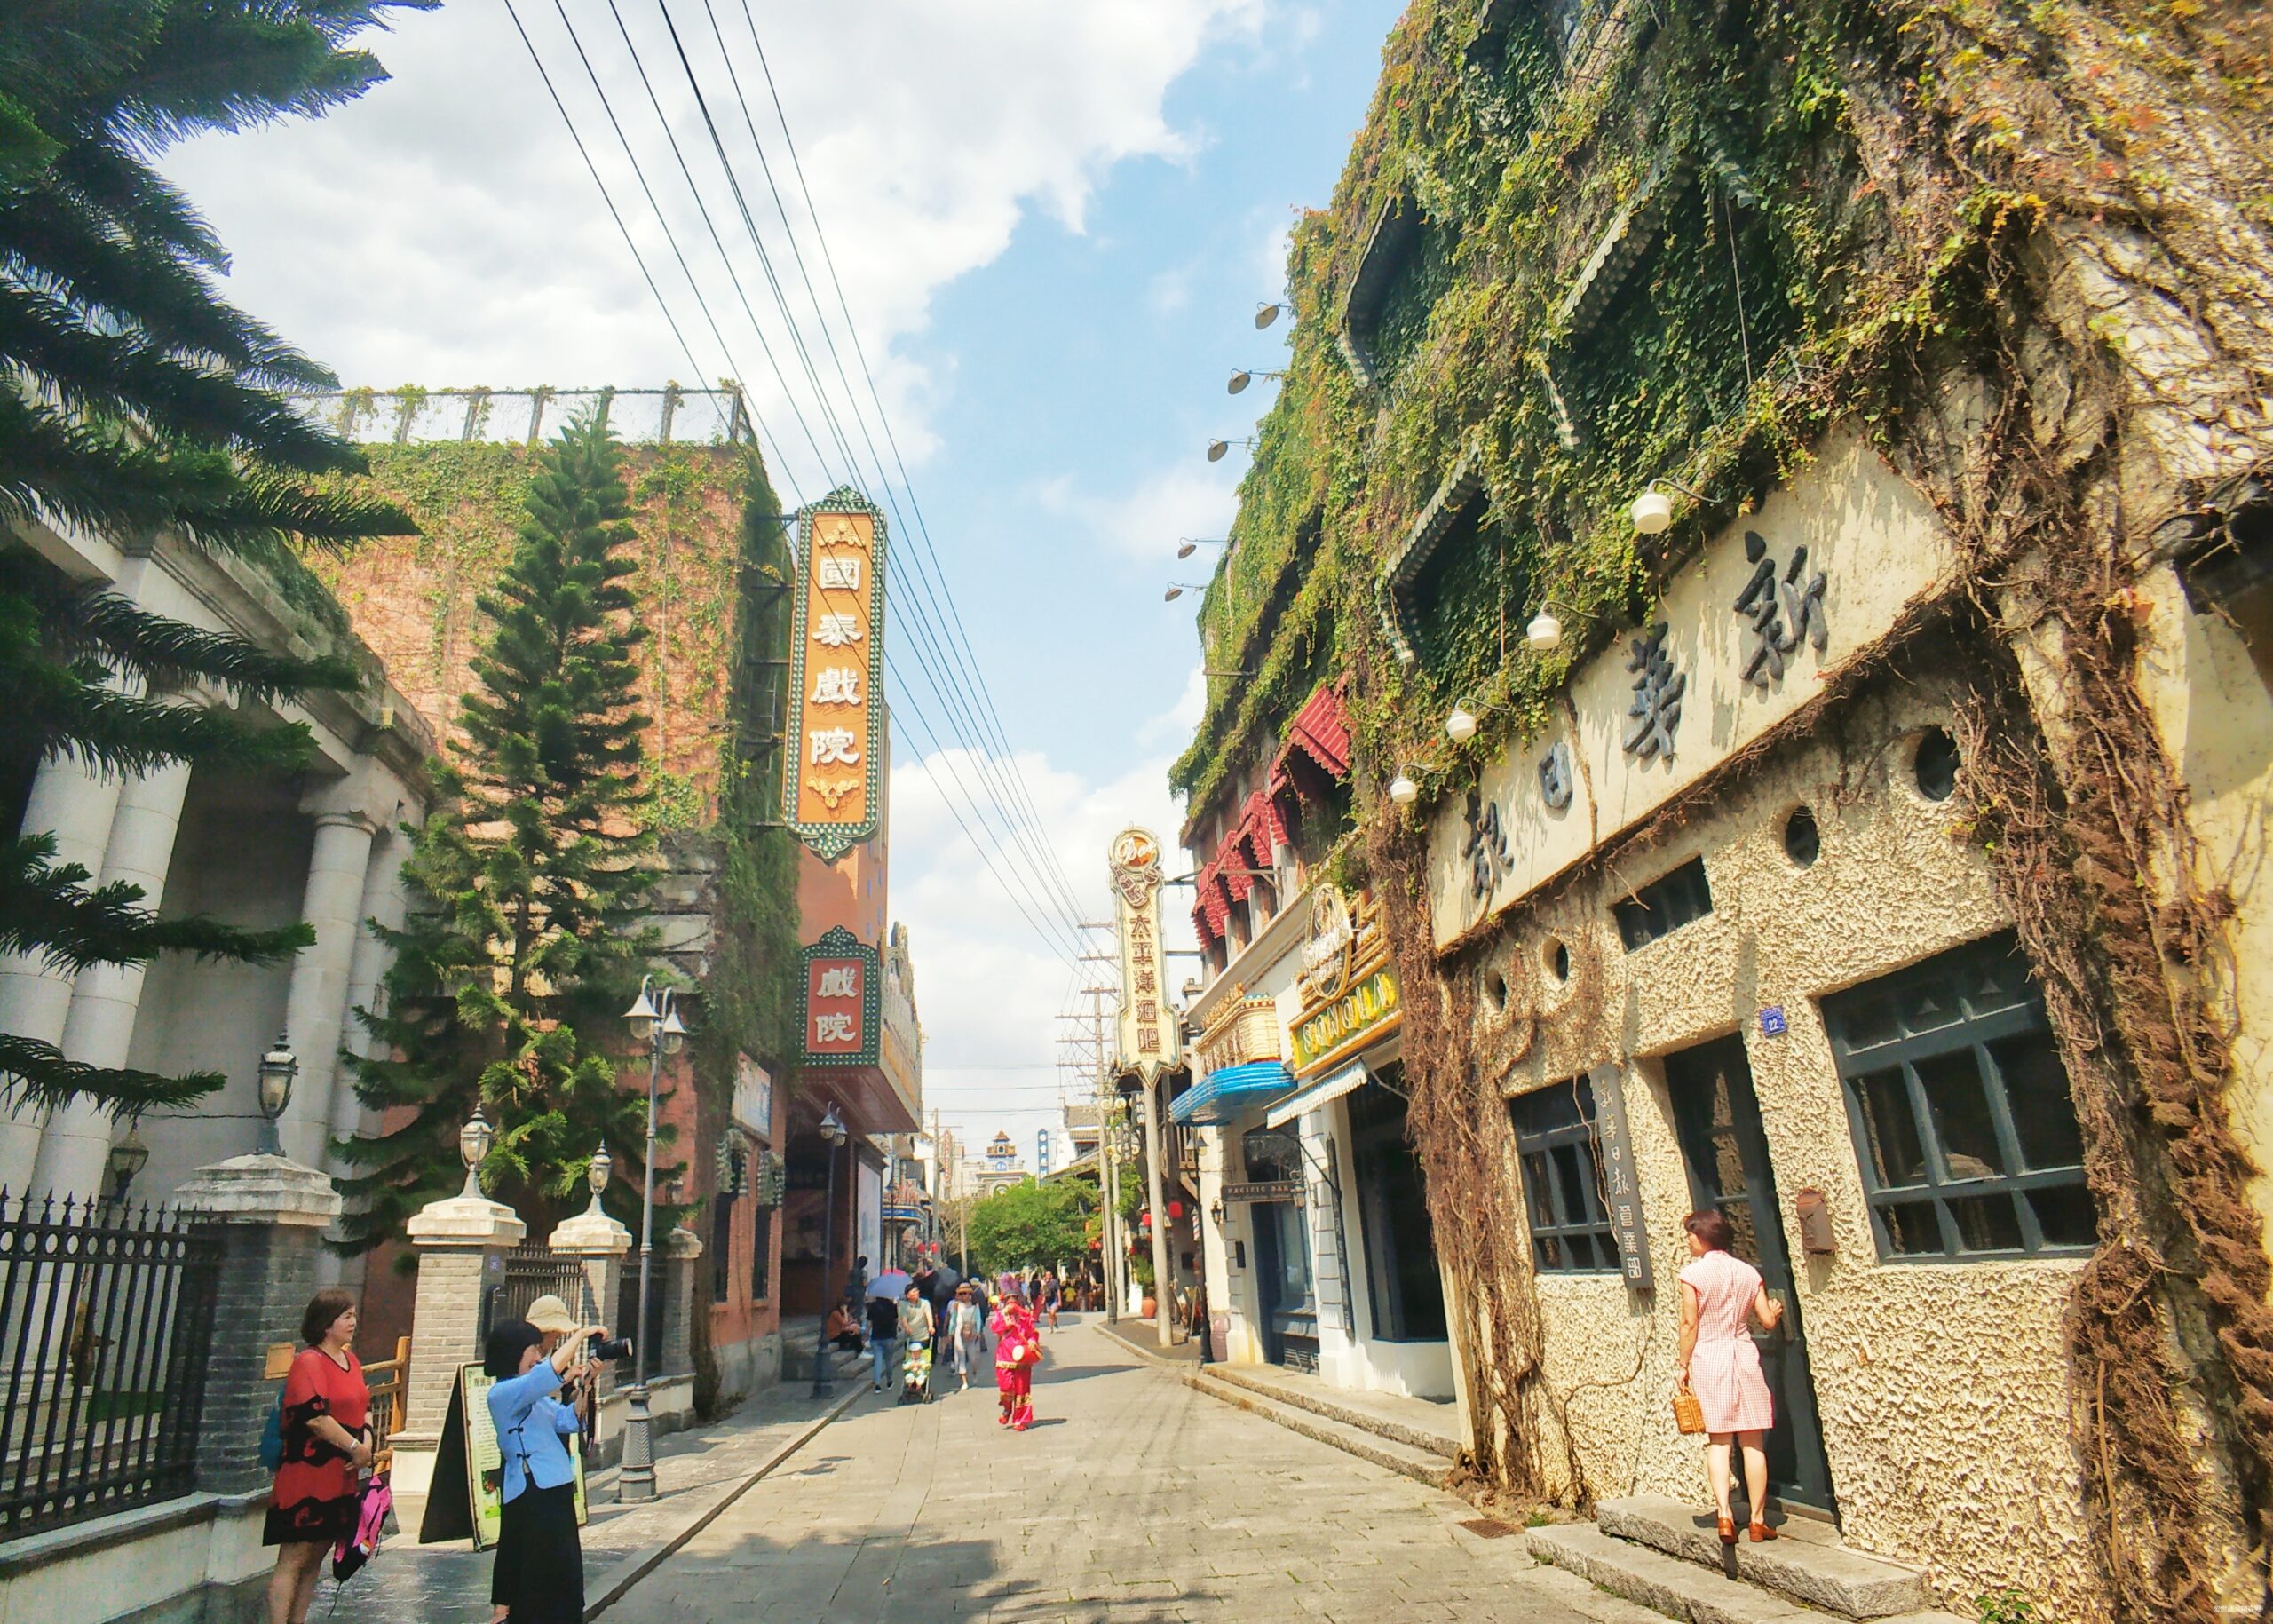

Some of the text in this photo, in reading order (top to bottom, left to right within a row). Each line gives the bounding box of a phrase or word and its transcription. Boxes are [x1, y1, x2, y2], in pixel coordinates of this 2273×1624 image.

[809, 557, 863, 765] 國泰戲院
[815, 967, 859, 1042] 戲院
[1129, 915, 1161, 1053] 太平洋酒吧
[1768, 1018, 1779, 1031] 22
